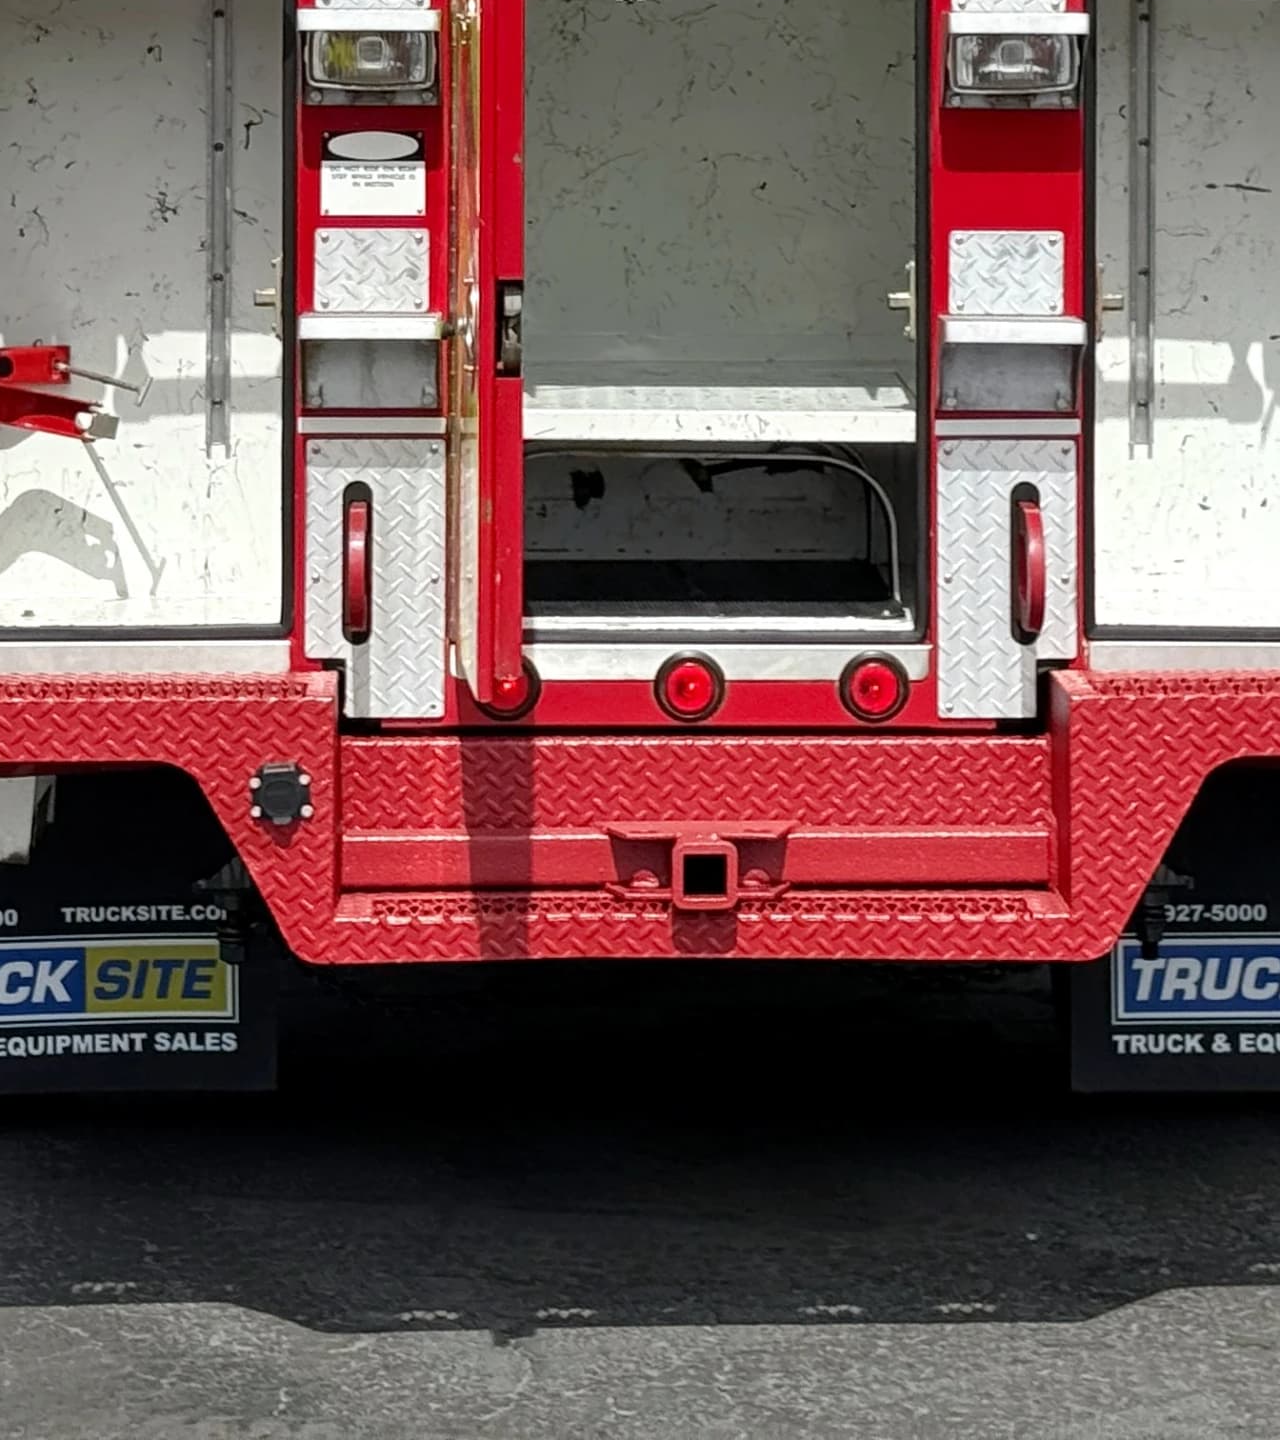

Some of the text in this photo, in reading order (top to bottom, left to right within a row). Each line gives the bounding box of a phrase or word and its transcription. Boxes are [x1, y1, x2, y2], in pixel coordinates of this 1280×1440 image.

[94, 959, 217, 1000] SITE
[154, 1032, 237, 1052] SALES
[1112, 1034, 1204, 1054] TRUCK
[1211, 1034, 1232, 1053] &
